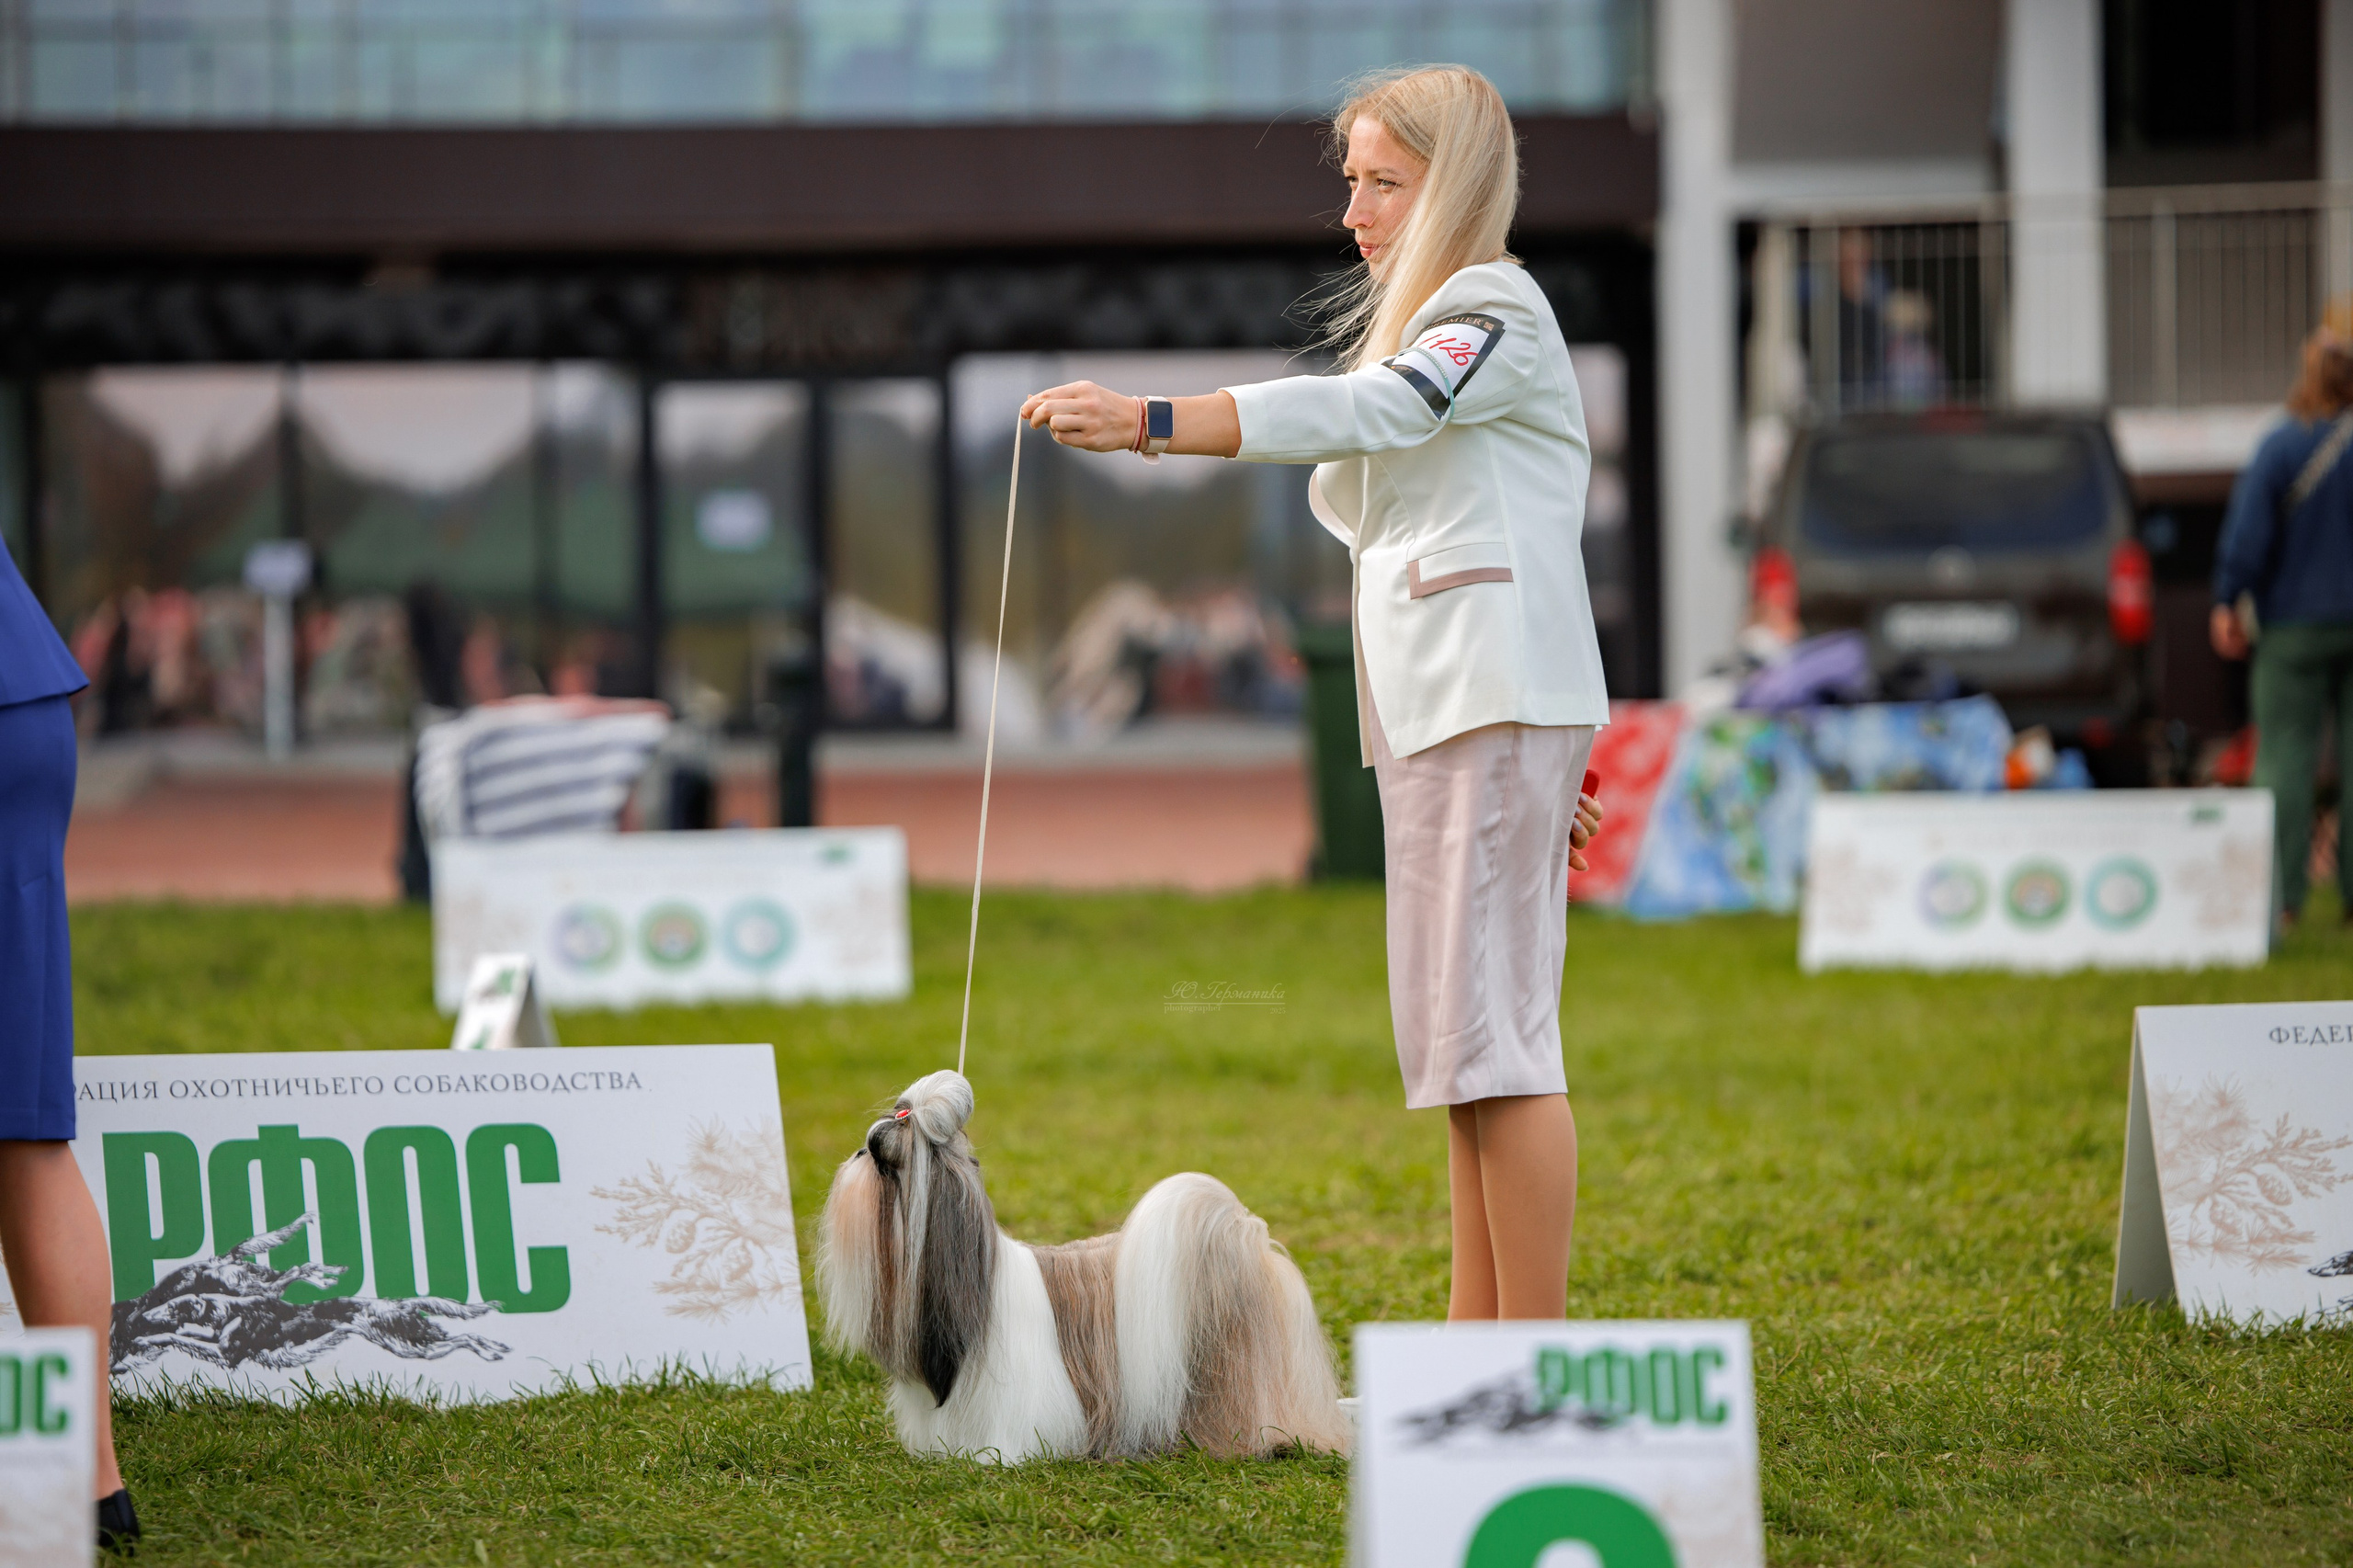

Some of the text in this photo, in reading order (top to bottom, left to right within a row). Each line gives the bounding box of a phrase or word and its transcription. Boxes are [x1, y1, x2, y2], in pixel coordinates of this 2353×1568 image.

[1427, 316, 1482, 331] PREMIER
[73, 1071, 643, 1104] АЦИЯ ОХОТНИЧЬЕГО СОБАКОВОДСТВА
[101, 1122, 572, 1315] РФОС
[1535, 1343, 1728, 1426] РФОС
